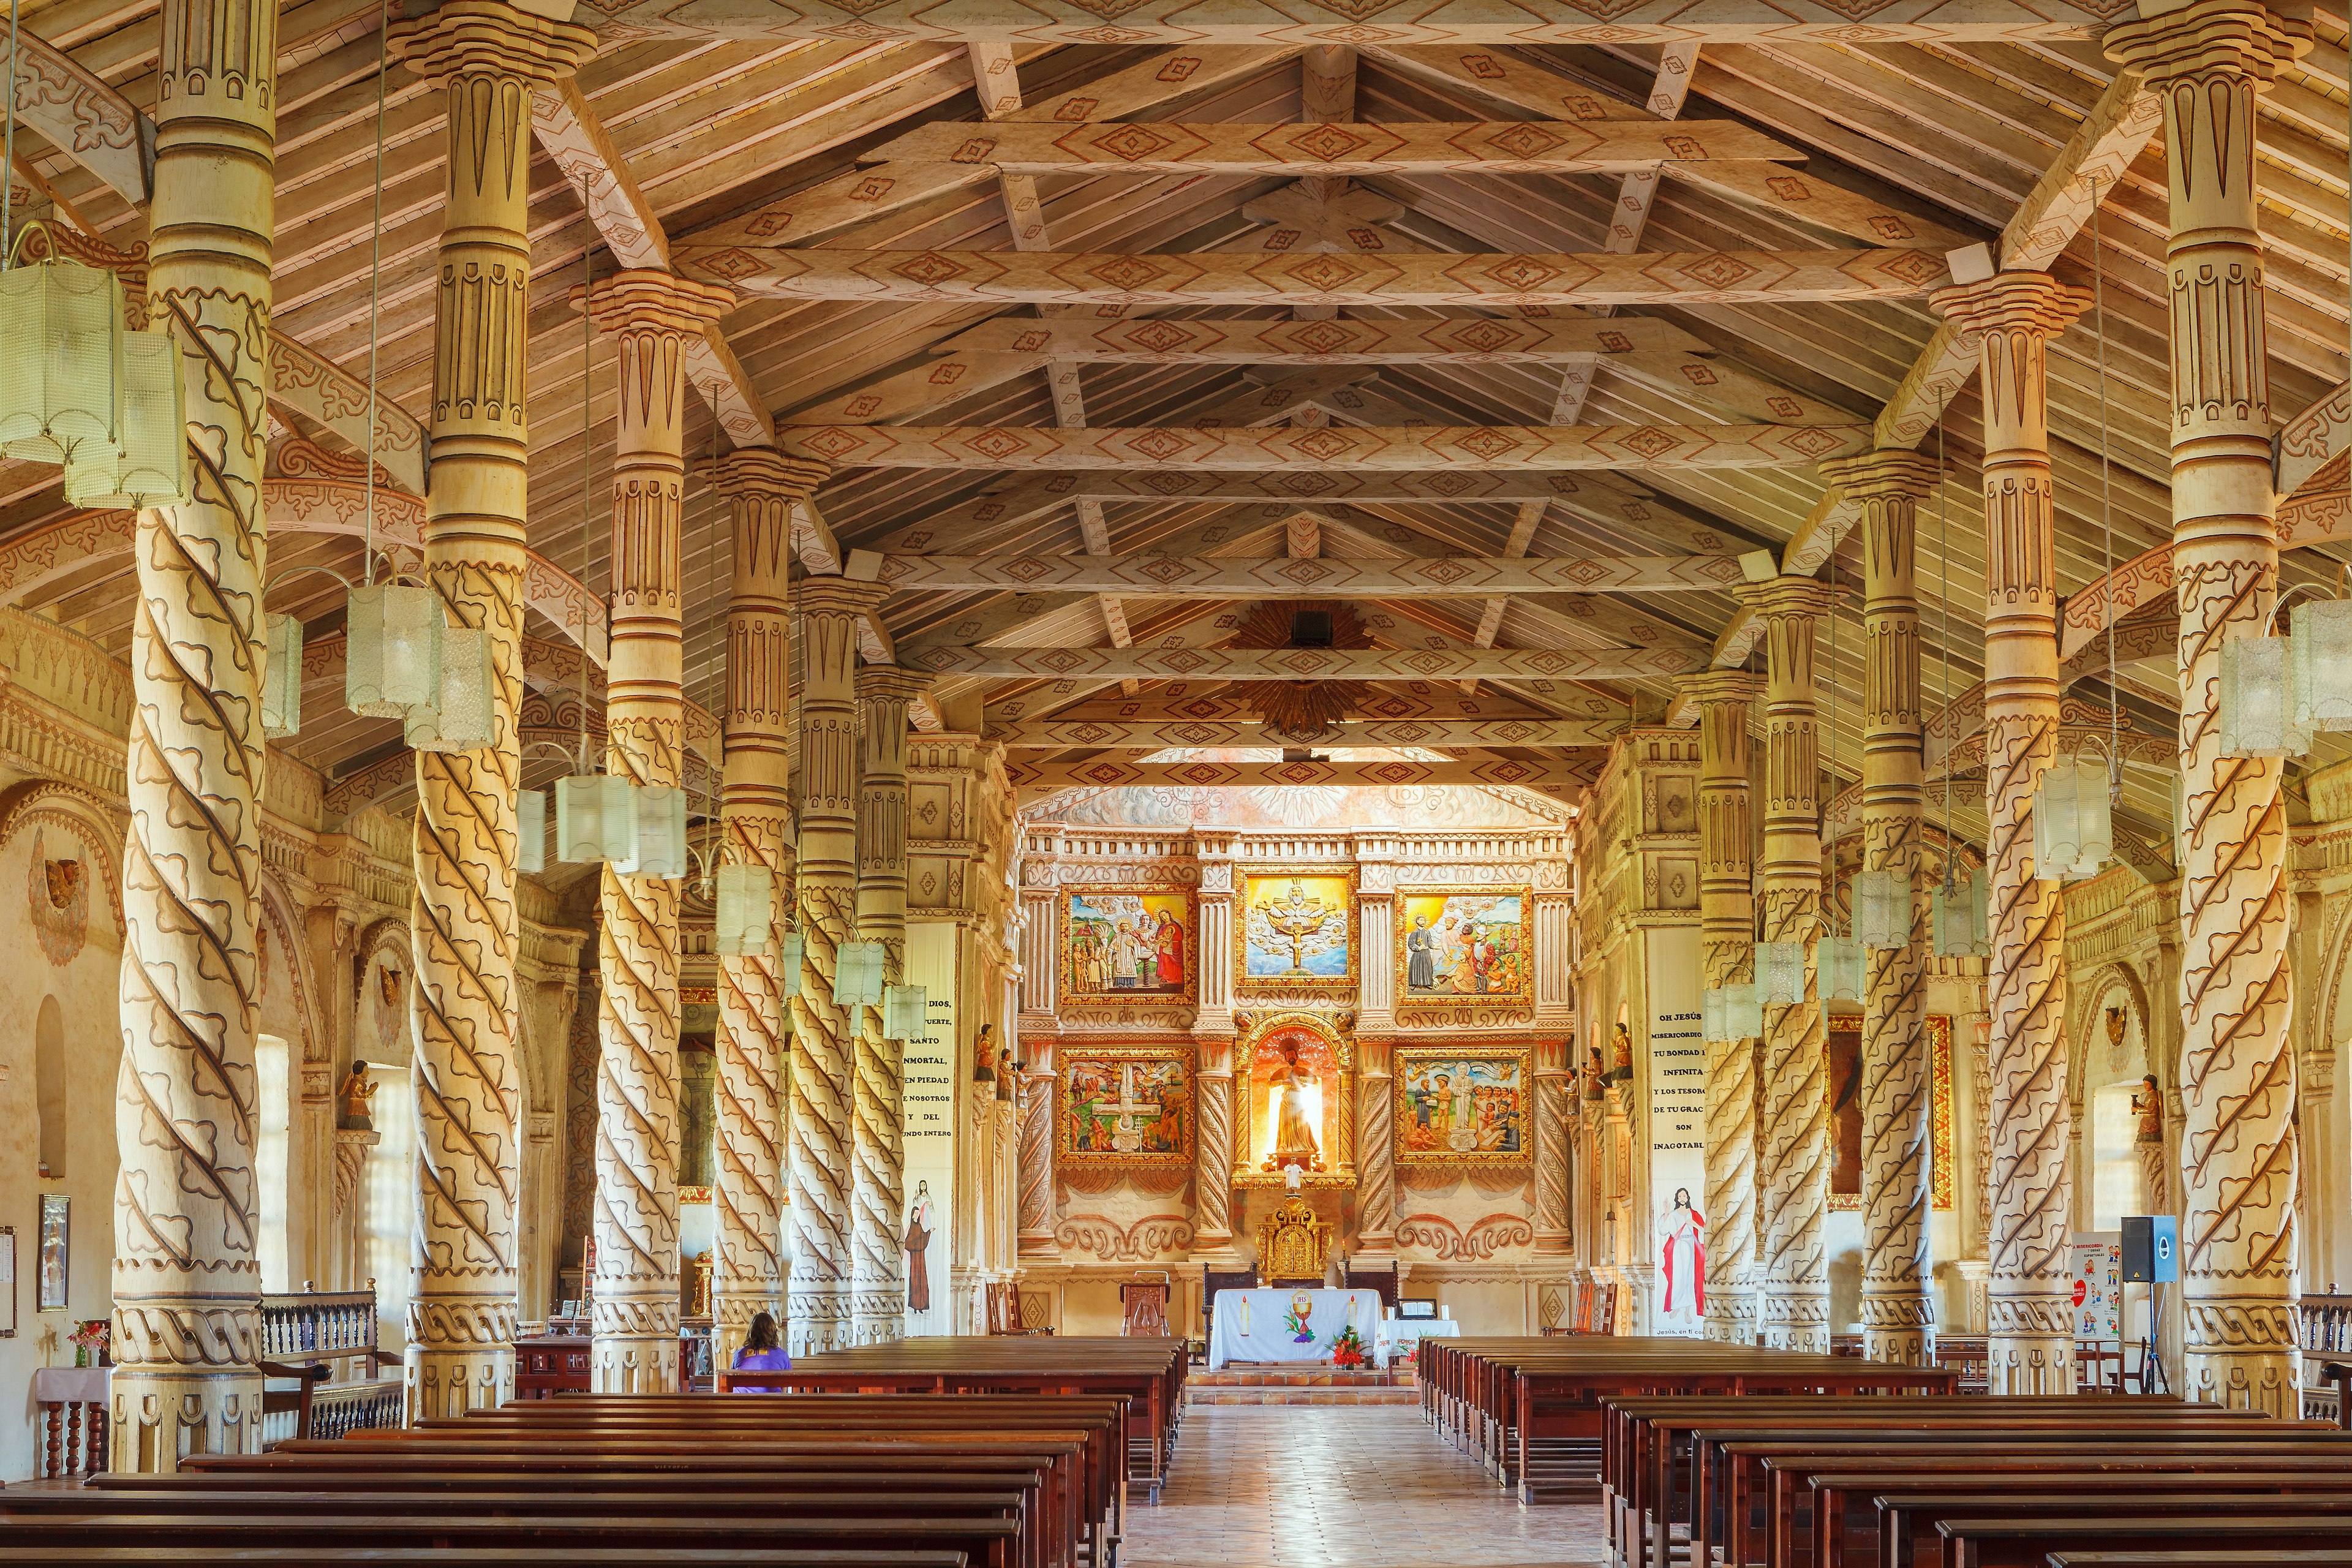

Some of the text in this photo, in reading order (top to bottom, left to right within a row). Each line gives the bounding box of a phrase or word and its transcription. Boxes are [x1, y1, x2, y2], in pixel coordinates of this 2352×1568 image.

[1395, 788, 1419, 801] IOS
[929, 1000, 951, 1009] DIOS,
[1673, 1011, 1702, 1020] JESÚS
